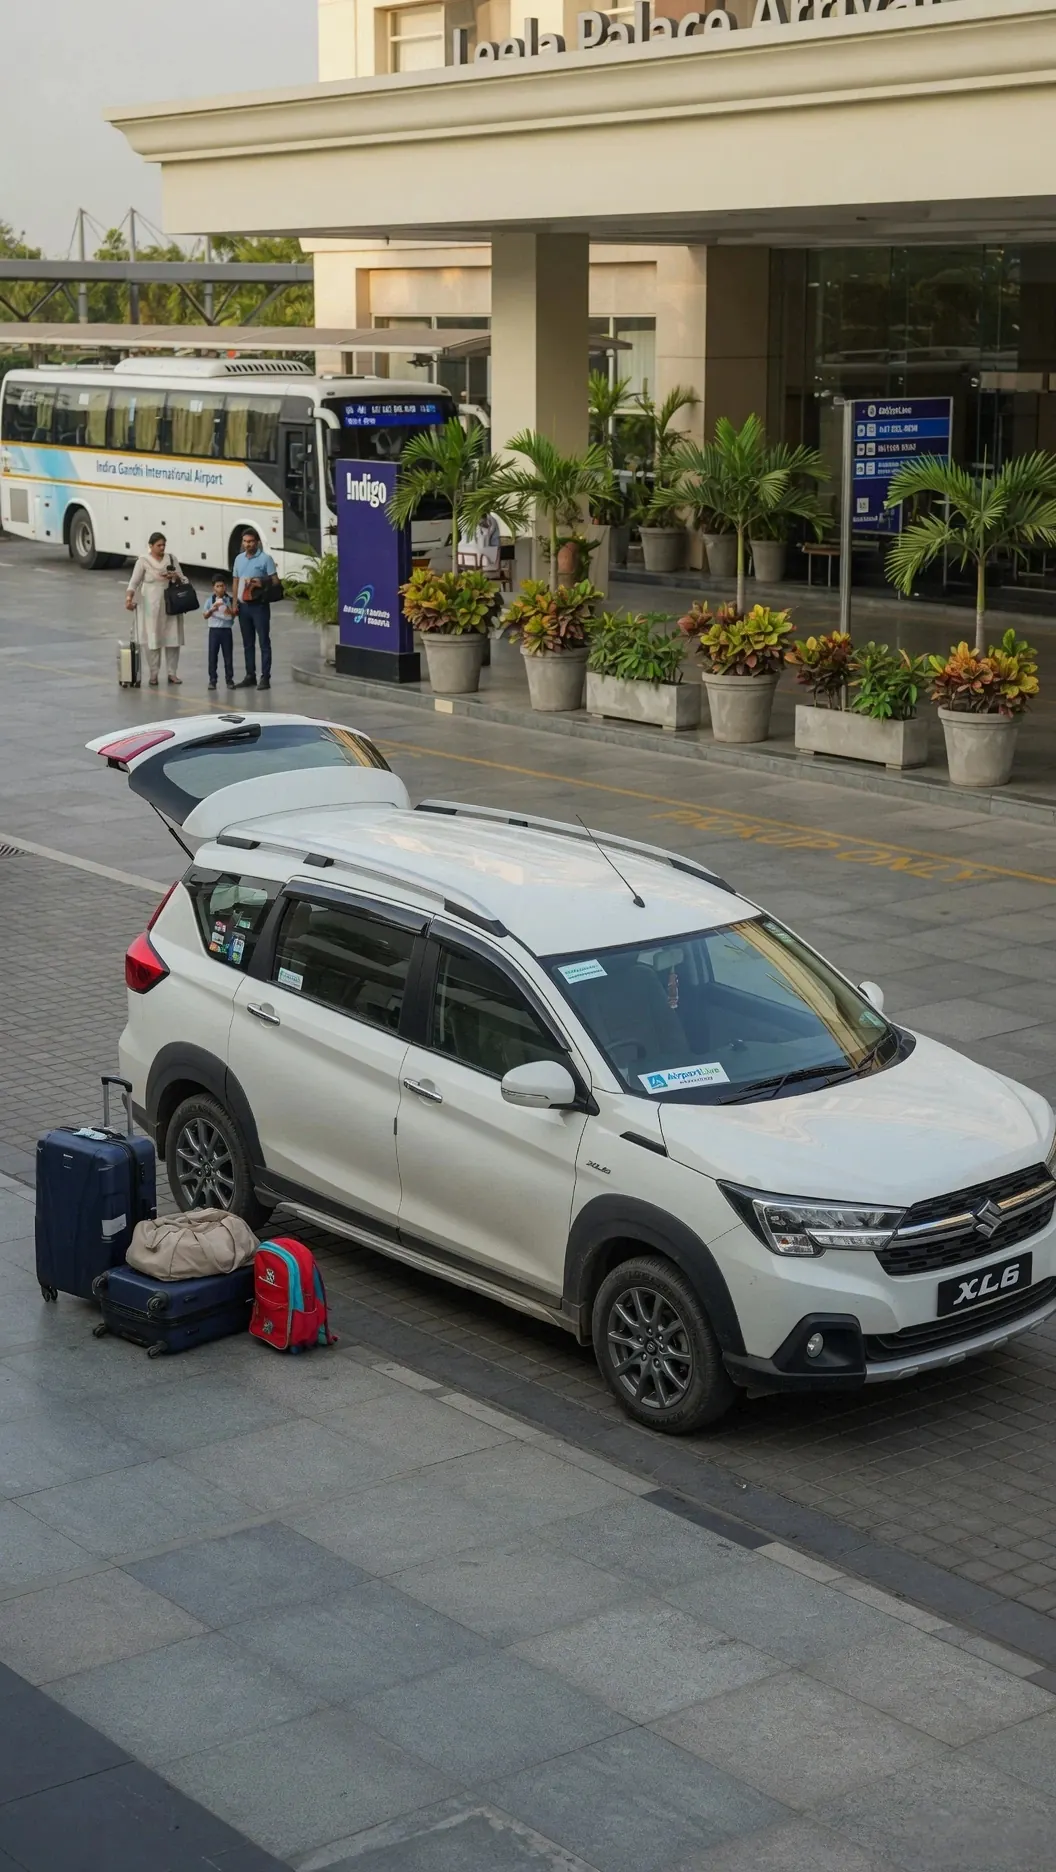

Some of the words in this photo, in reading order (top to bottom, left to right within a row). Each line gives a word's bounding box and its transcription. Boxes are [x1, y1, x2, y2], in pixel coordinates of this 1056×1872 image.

[578, 1, 738, 50] Palace
[96, 460, 117, 474] Indira
[118, 462, 143, 477] Gandhi
[145, 464, 192, 482] International
[194, 469, 223, 487] Airport
[648, 810, 840, 849] PICKUP
[952, 1263, 1020, 1306] XL6
